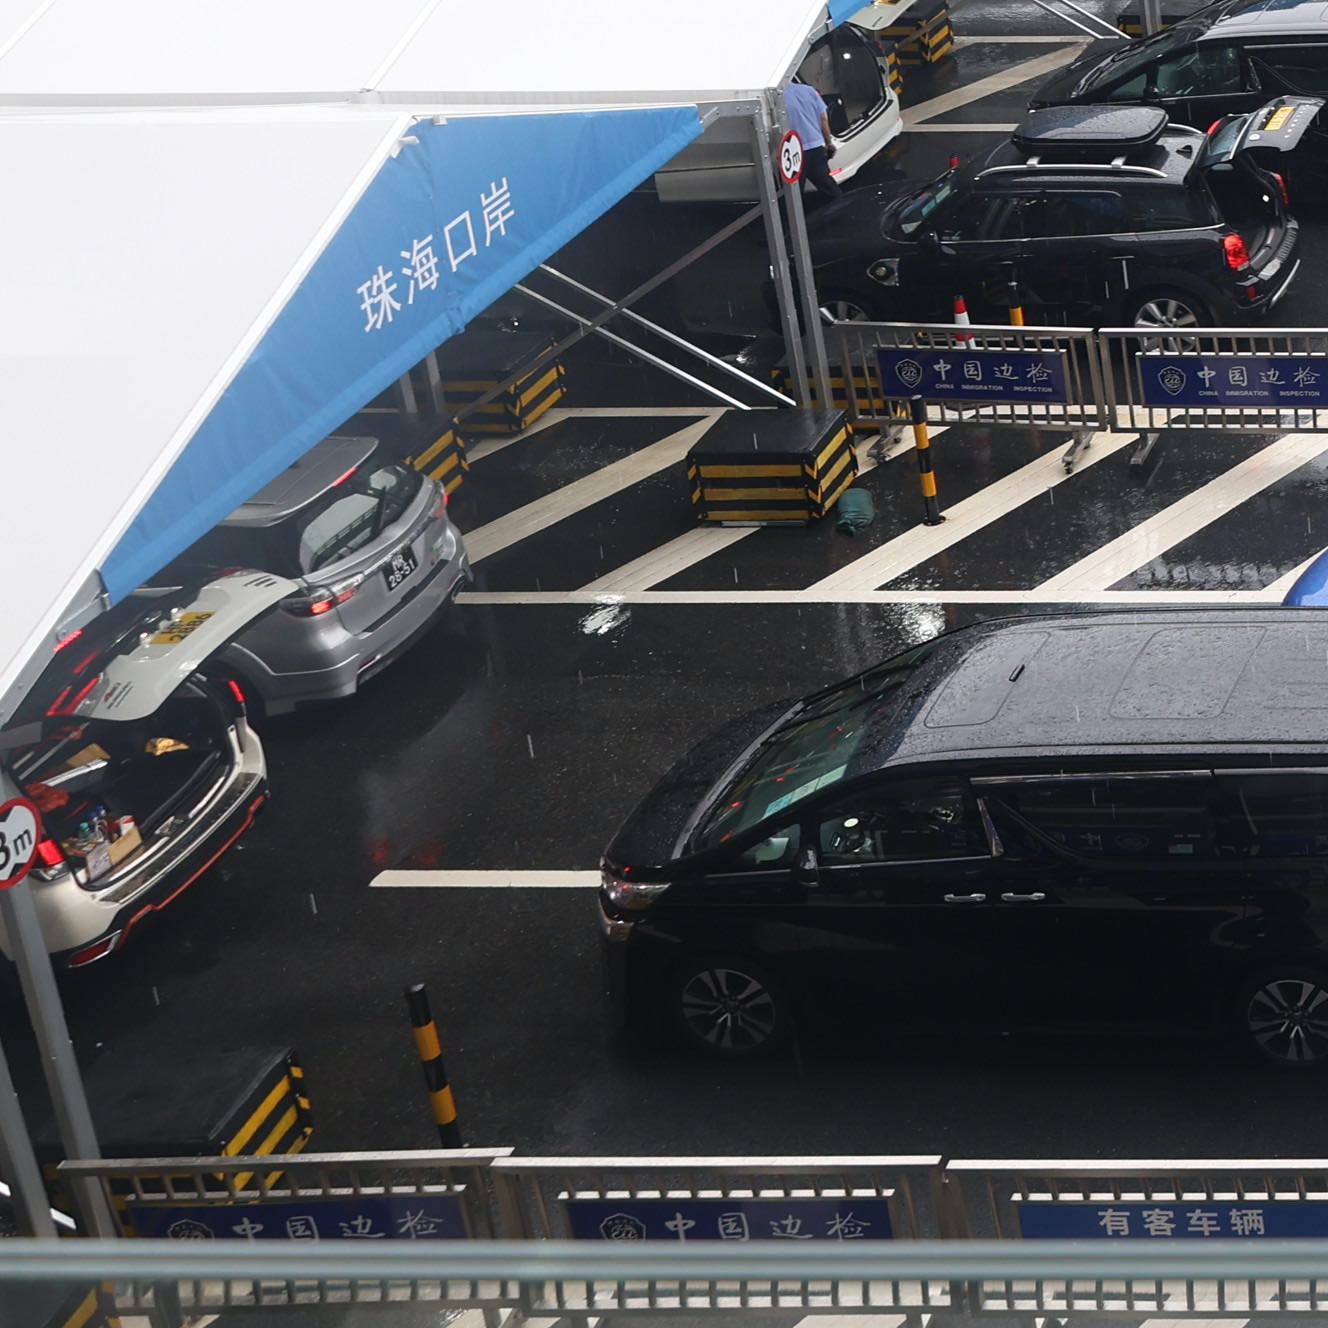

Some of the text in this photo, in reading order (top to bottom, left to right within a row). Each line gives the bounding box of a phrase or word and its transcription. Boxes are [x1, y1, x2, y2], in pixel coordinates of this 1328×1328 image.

[356, 177, 516, 333] 珠海口岸
[933, 359, 1053, 382] 中国边检
[1197, 366, 1321, 388] 中国边检
[231, 1209, 445, 1242] 中国边检
[664, 1212, 871, 1241] 中国边检
[1097, 1208, 1265, 1237] 有客车辆
